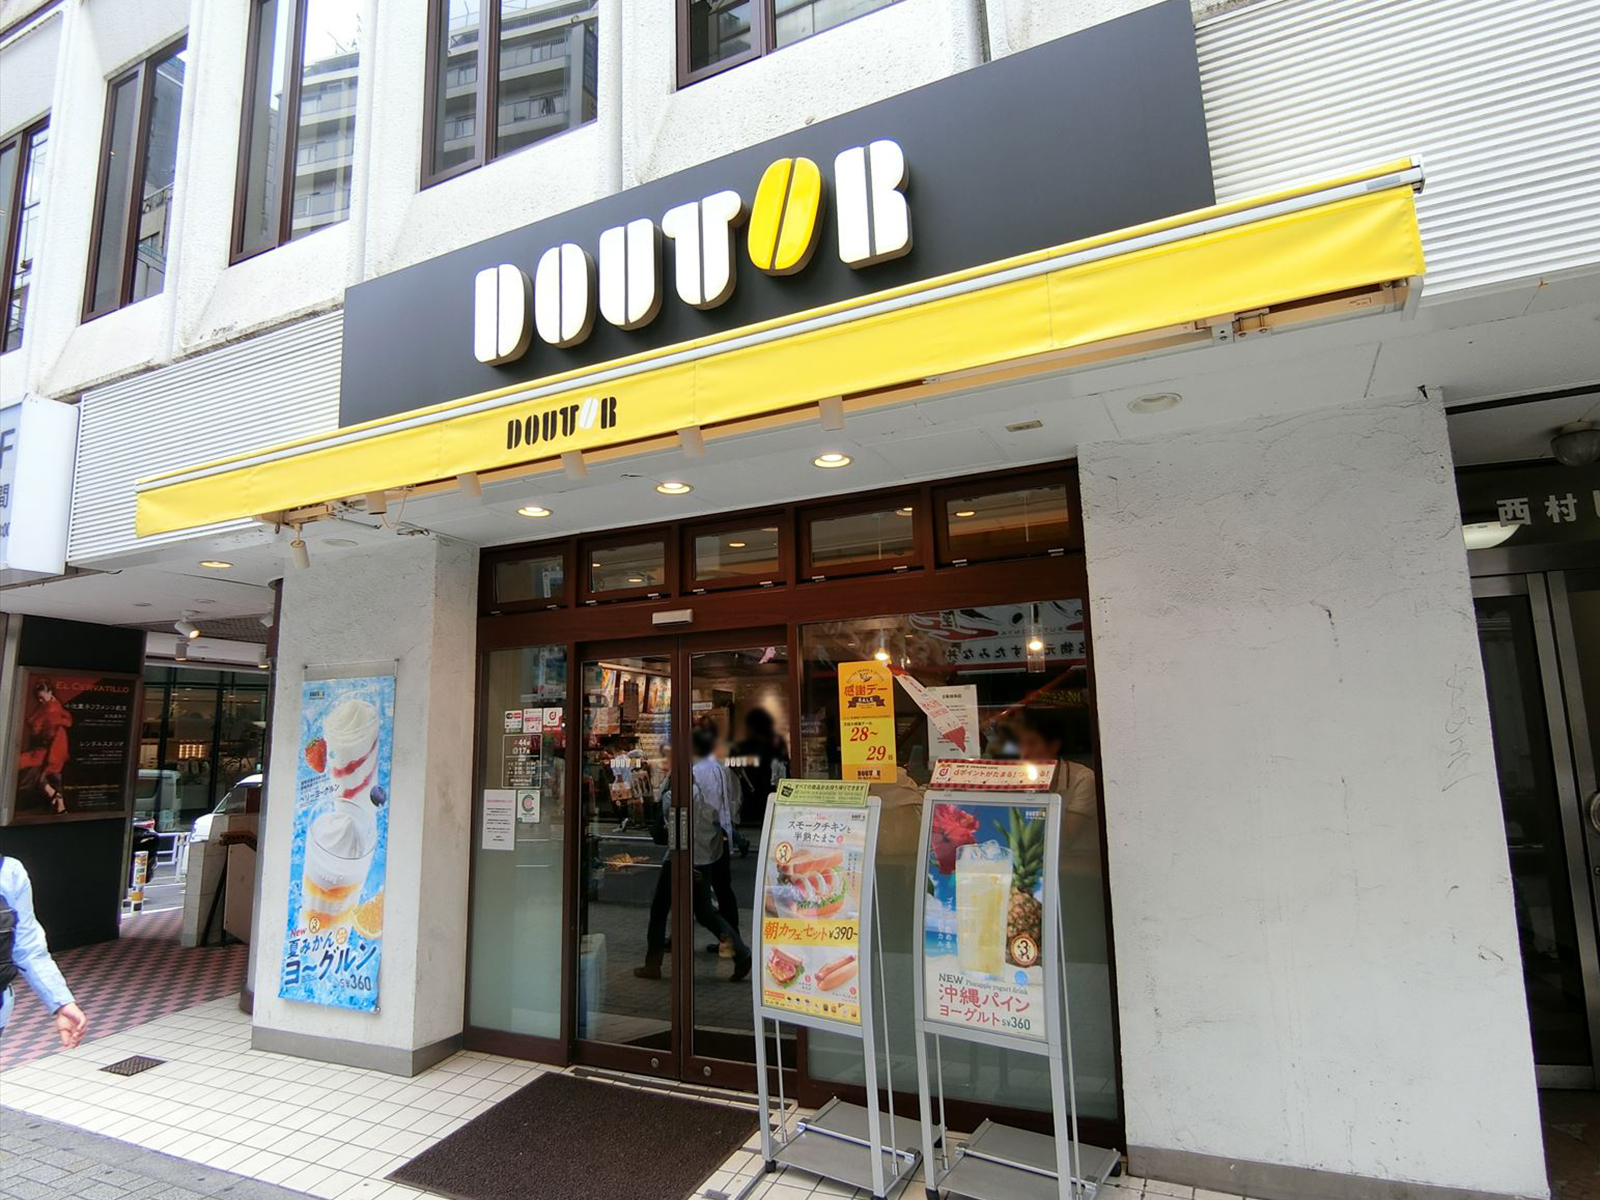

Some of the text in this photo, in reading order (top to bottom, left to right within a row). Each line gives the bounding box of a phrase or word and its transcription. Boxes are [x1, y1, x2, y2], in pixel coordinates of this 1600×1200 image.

[474, 139, 913, 367] DOUTOR
[507, 397, 617, 449] DOUTOR
[788, 820, 851, 834] スモークチキンと
[794, 831, 836, 843] 半熟たまご
[764, 922, 828, 941] 朝カフェセット
[287, 931, 335, 959] 夏みかん
[939, 973, 964, 984] NEW
[1012, 987, 1028, 995] drink
[938, 984, 1030, 1013] 沖縄パイン
[940, 1004, 1000, 1026] ヨーグルト
